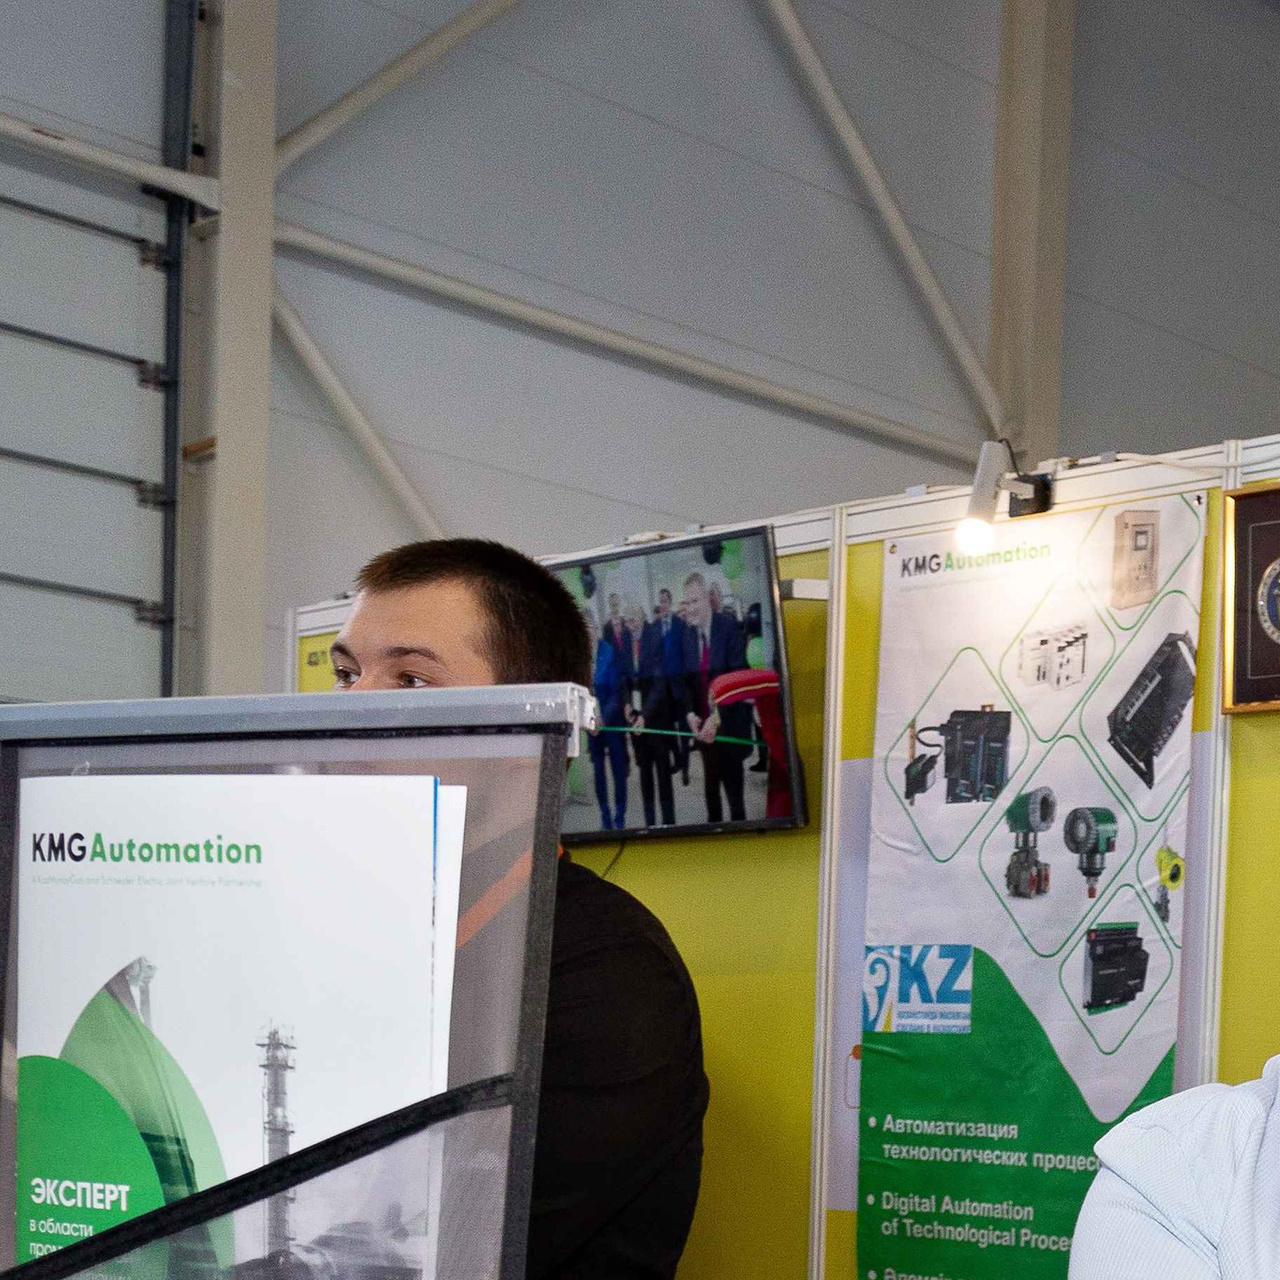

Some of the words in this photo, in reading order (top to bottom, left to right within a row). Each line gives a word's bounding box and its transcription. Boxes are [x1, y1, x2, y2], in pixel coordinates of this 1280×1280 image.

[32, 832, 263, 864] KMGAutomation
[897, 945, 973, 1005] KZ
[882, 1113, 1018, 1141] Автоматизация
[882, 1144, 1028, 1168] технологических
[30, 1178, 130, 1212] ЭКСПЕРТ
[881, 1191, 936, 1216] Digital
[940, 1195, 1035, 1221] Automation
[29, 1219, 37, 1232] в
[38, 1218, 94, 1238] области
[881, 1218, 899, 1236] of
[903, 1218, 1015, 1249] Technological
[1019, 1227, 1073, 1252] Proce
